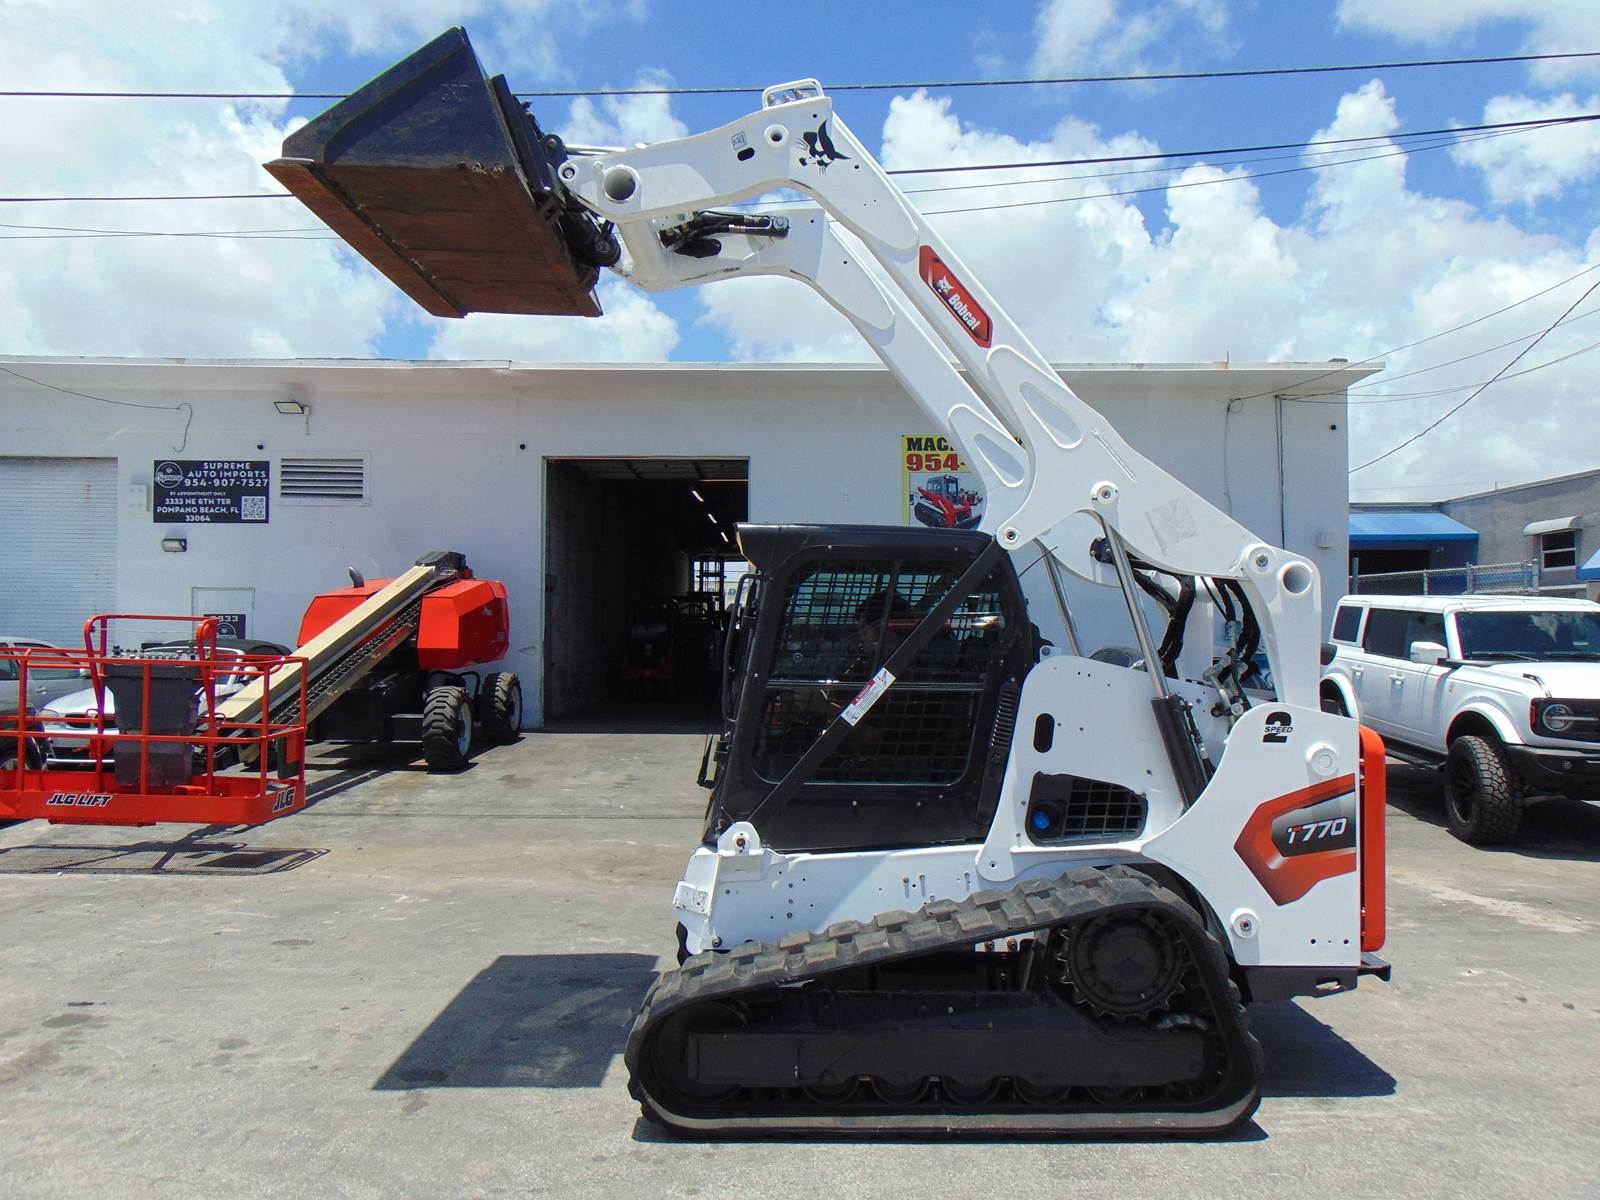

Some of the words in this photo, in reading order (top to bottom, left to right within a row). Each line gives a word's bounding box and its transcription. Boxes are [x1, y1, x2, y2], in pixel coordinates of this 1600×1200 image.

[947, 293, 981, 330] Bobcat
[906, 437, 954, 451] MAC
[203, 462, 251, 470] SUPREME
[187, 470, 217, 478] AUTO
[219, 470, 267, 478] IMPORTS
[184, 478, 268, 487] 954-907-7527
[199, 506, 228, 514] BEACH,
[1262, 711, 1292, 743] 2
[1264, 725, 1293, 733] SPEED
[47, 792, 78, 806] JLG
[75, 793, 113, 807] LIFT
[272, 786, 297, 813] JLG
[1287, 817, 1348, 844] T770
